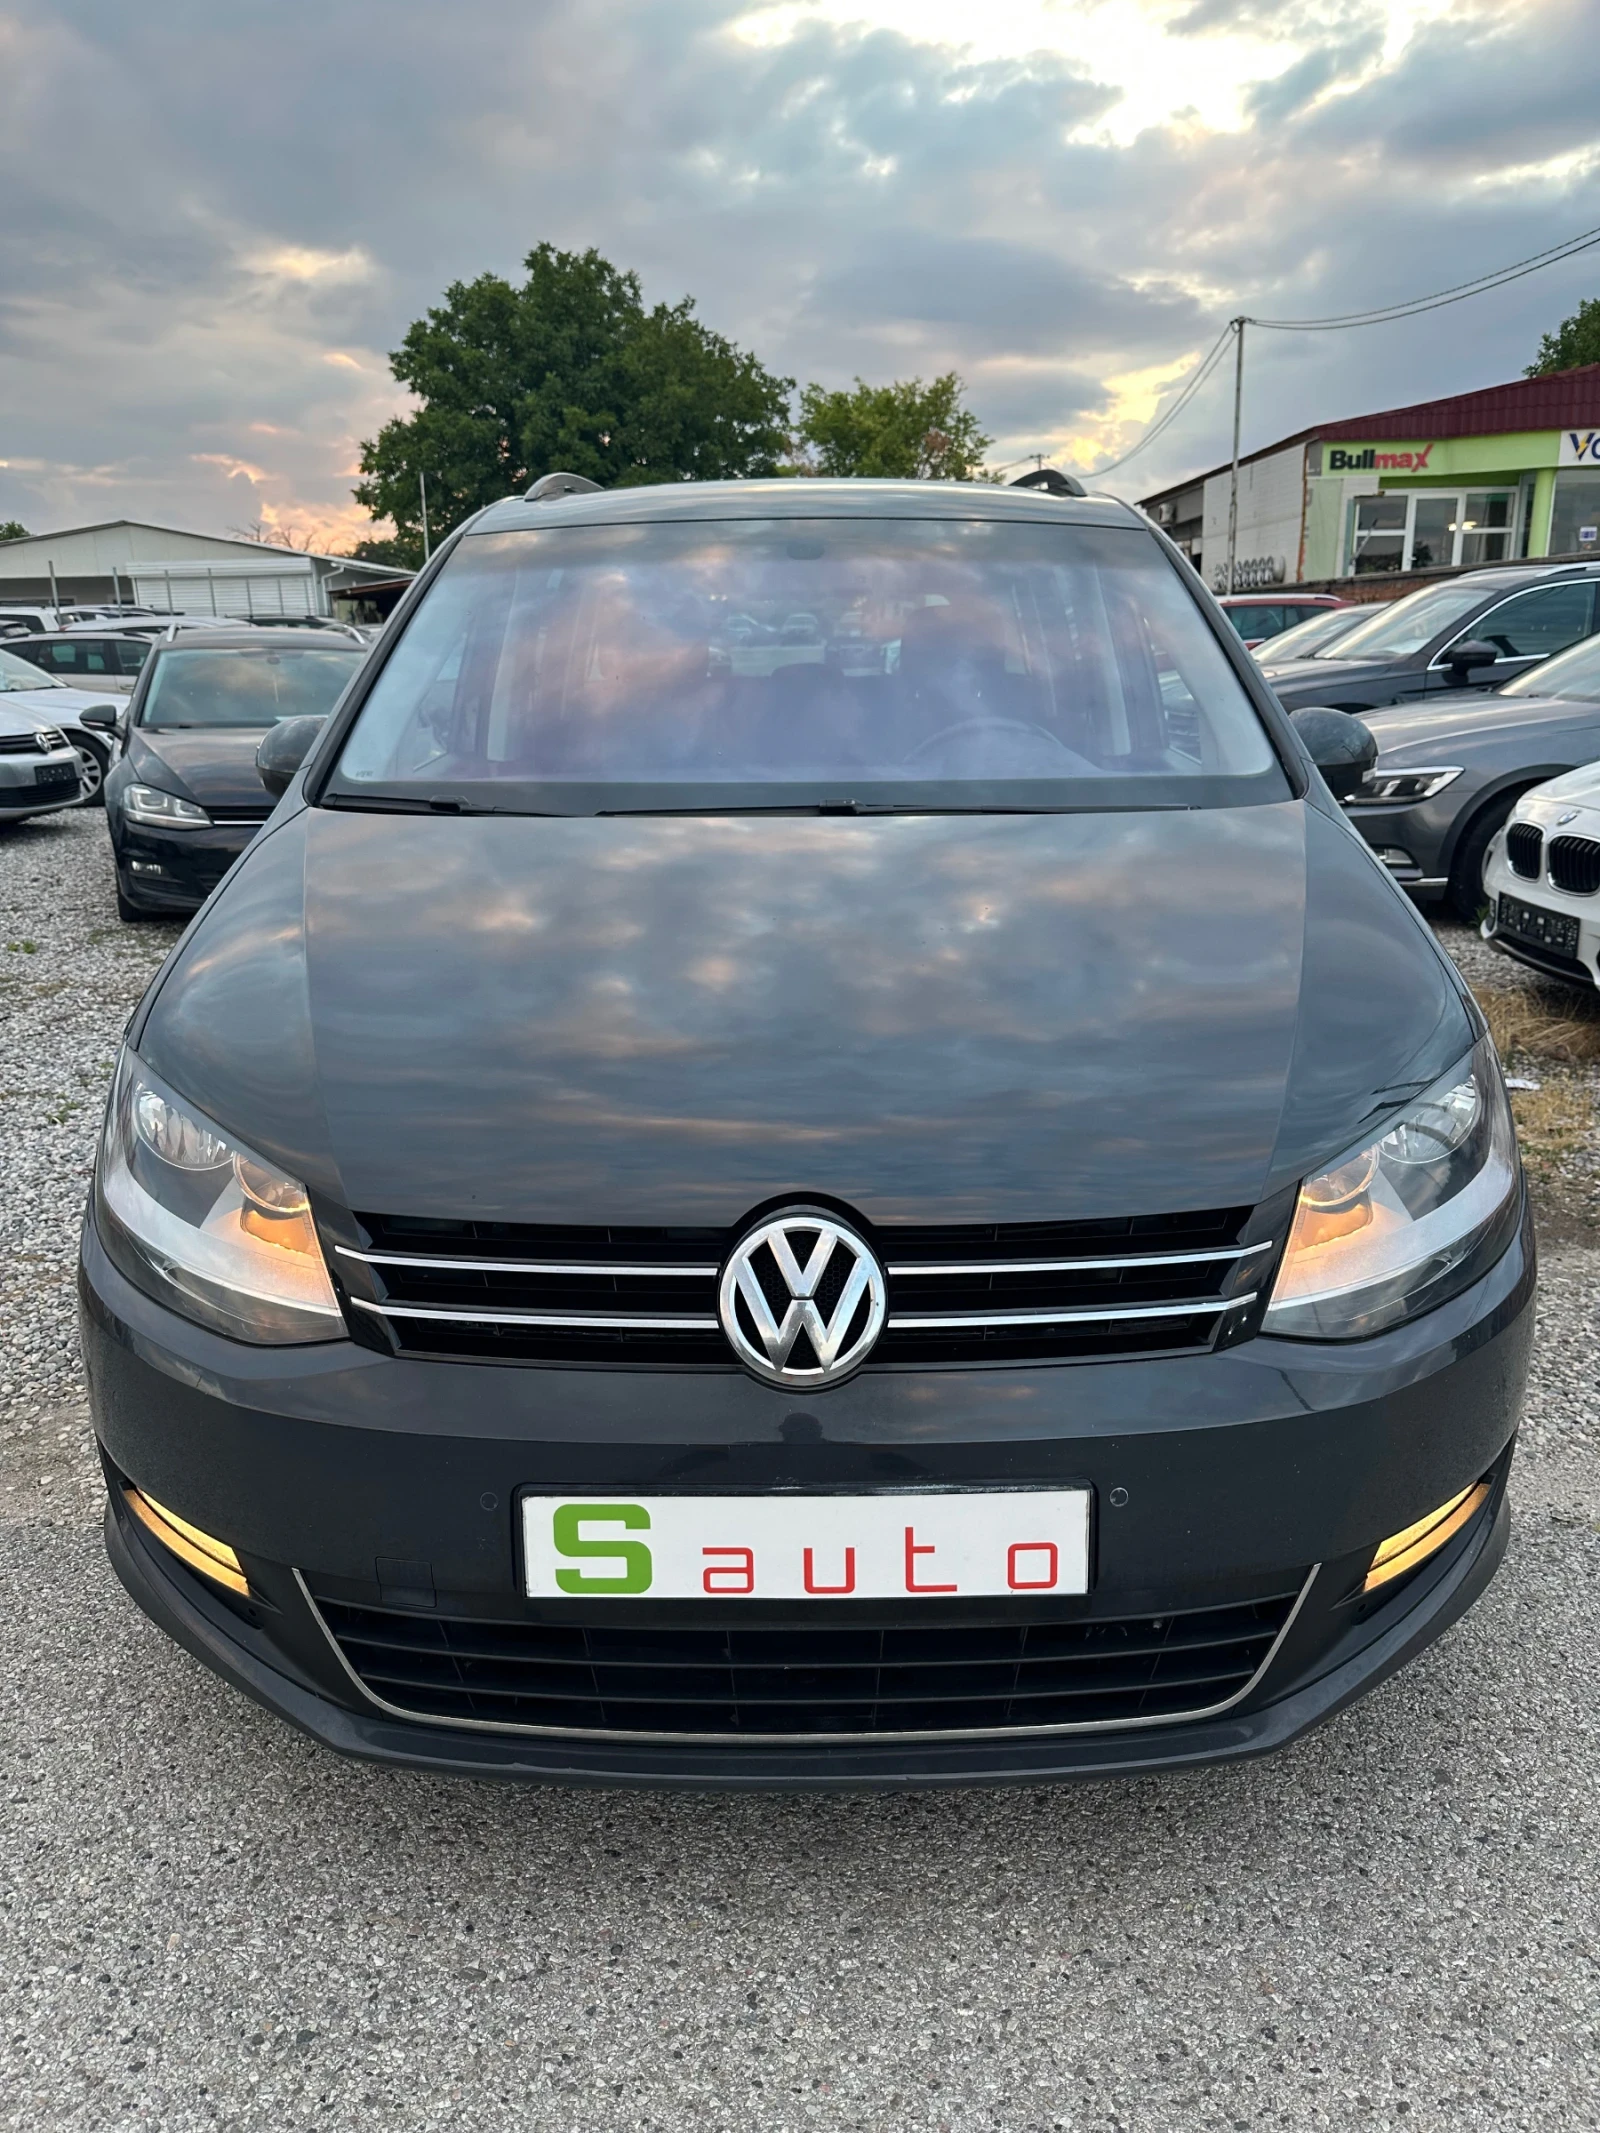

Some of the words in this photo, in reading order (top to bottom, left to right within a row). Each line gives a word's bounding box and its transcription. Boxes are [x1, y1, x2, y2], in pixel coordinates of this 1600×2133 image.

[1329, 443, 1434, 472] Bullmax
[553, 1503, 653, 1595] S
[702, 1526, 1058, 1593] auto
